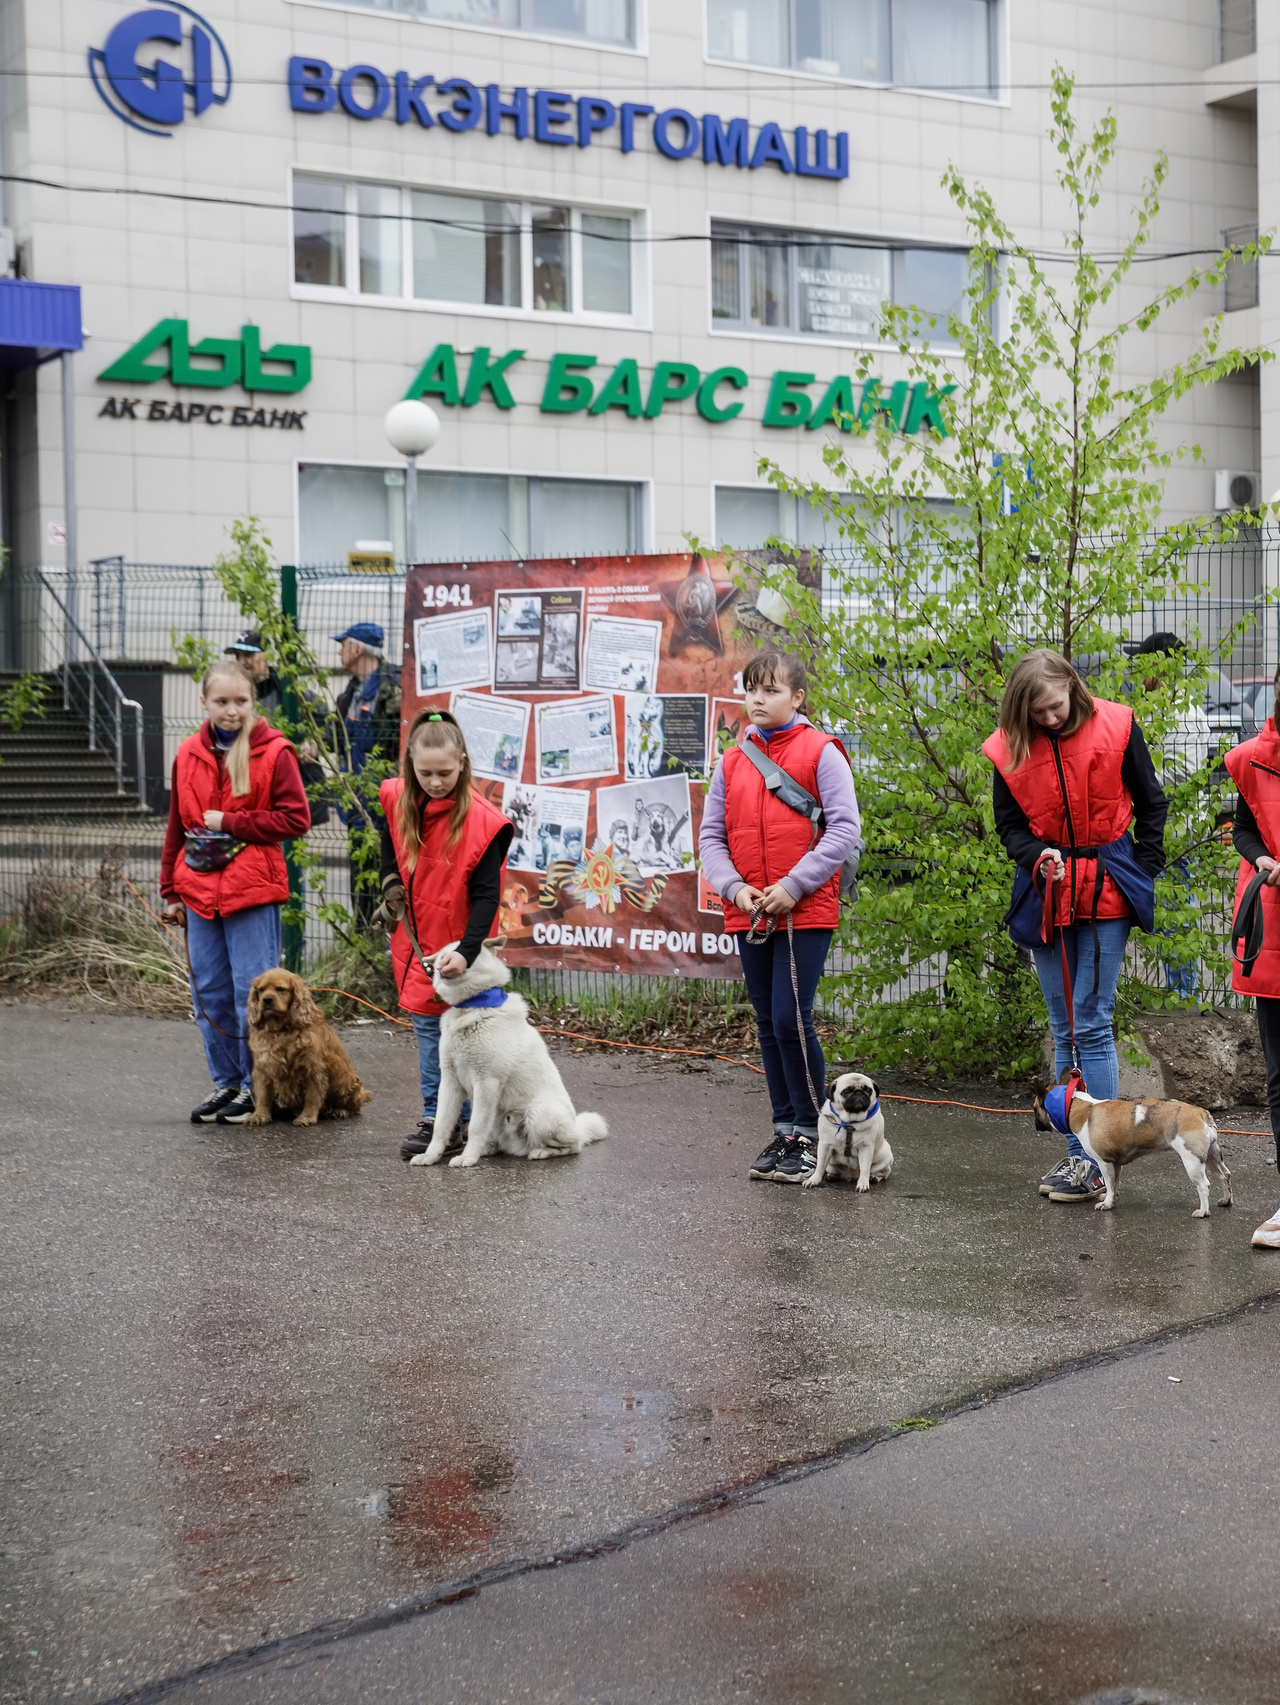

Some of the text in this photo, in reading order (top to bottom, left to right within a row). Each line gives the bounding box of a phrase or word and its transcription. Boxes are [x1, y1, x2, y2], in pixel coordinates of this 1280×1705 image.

[288, 55, 850, 180] ВОКЭНЕРГОМАШ
[401, 343, 960, 438] АК БАРС БАНК
[98, 396, 308, 431] АК БАРС БАНК
[422, 583, 474, 608] 1941
[532, 922, 614, 949] СОБАКИ
[629, 928, 697, 954] ГЕРОИ
